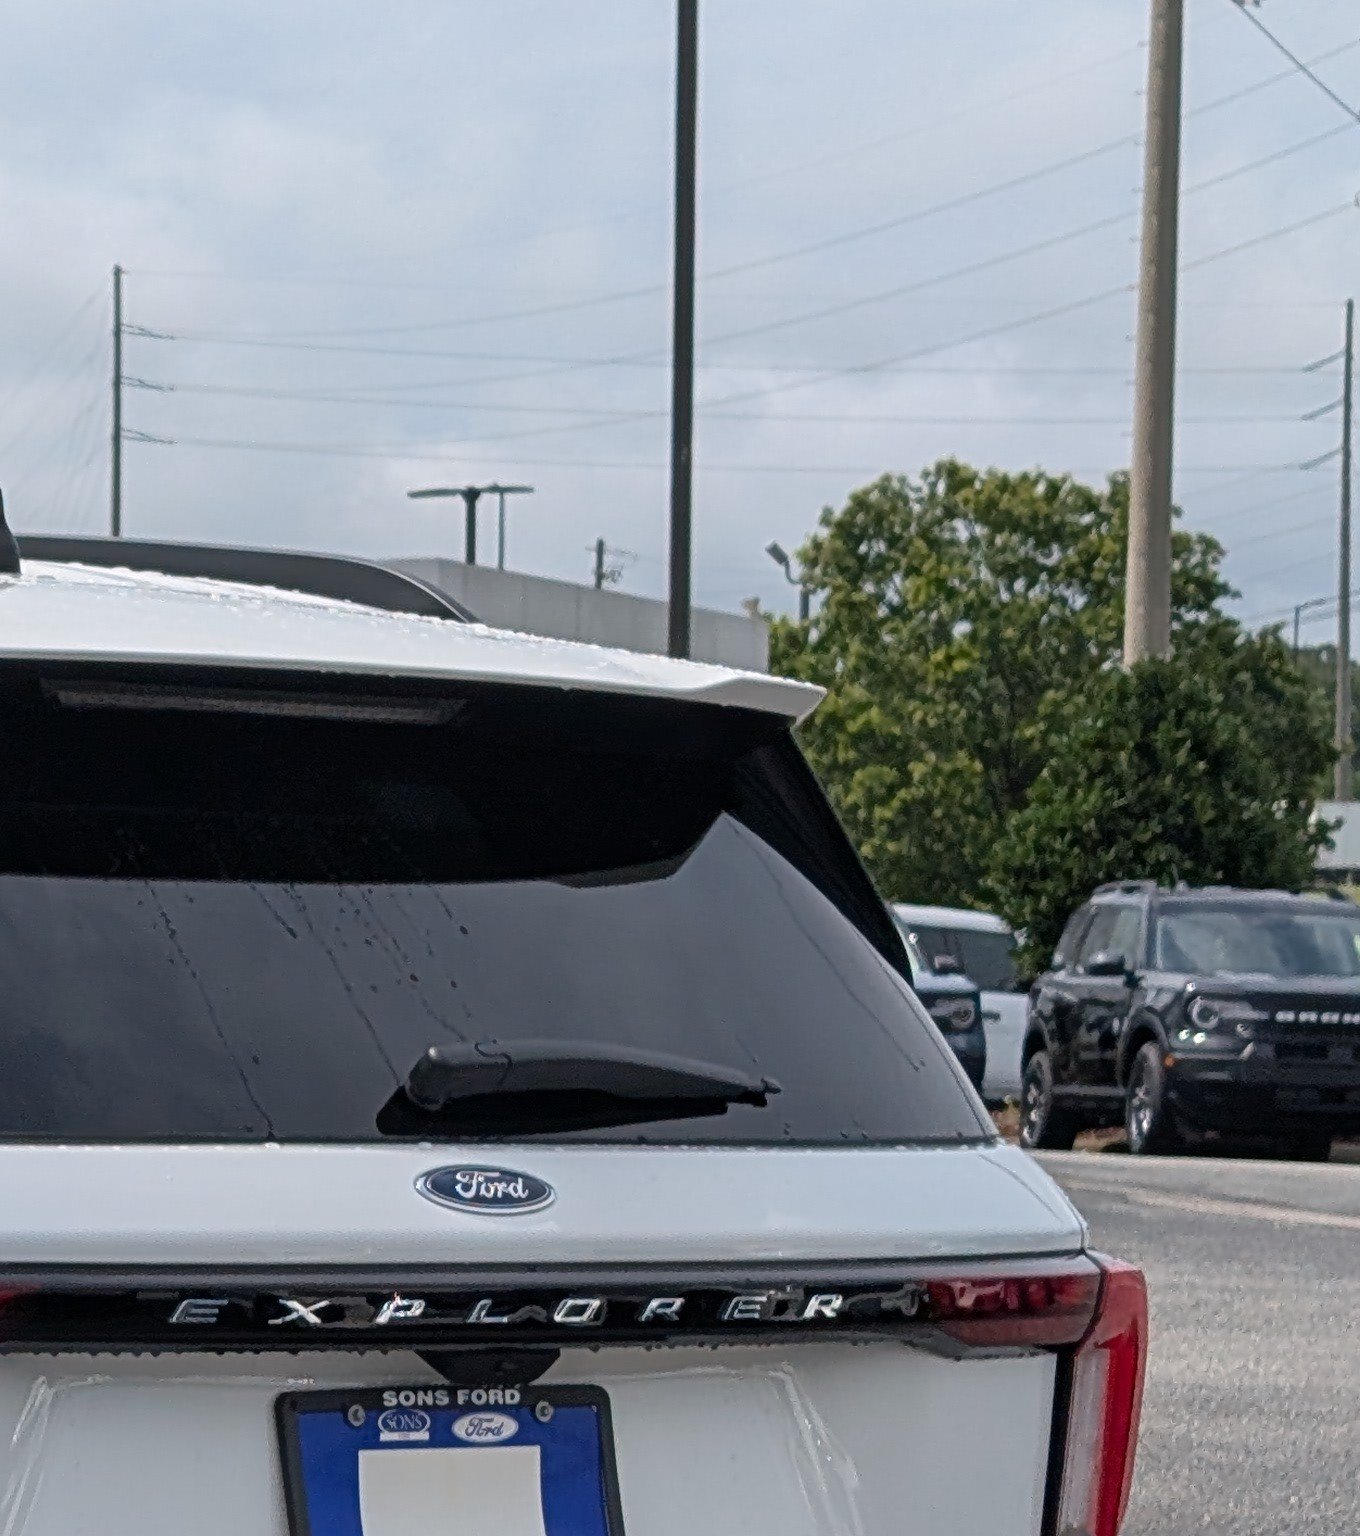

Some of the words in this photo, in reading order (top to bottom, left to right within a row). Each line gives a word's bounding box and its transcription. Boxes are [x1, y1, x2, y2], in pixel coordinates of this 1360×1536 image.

[454, 1171, 529, 1199] Ford
[167, 1292, 847, 1327] EXPLORER
[382, 1389, 450, 1407] SONS
[457, 1388, 521, 1406] FORD
[464, 1416, 505, 1437] Ford
